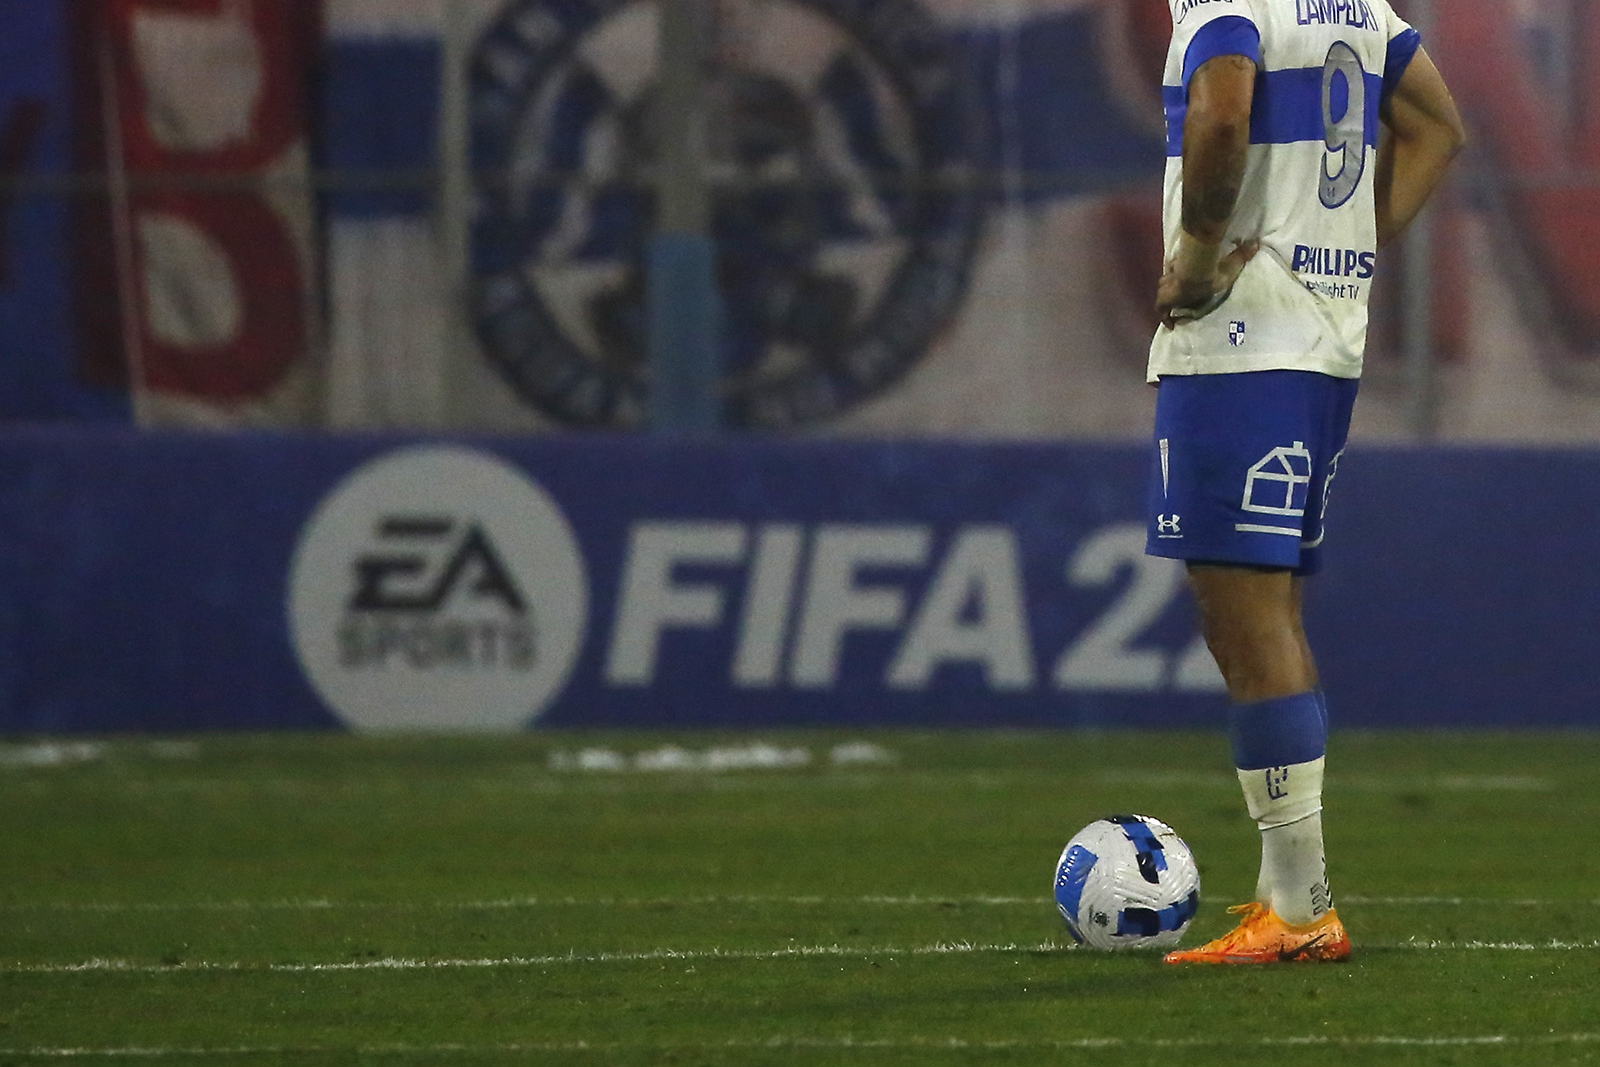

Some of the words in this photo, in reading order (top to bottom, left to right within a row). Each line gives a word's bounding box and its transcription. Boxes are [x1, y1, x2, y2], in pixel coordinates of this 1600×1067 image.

[1317, 40, 1365, 209] 9
[1291, 244, 1375, 279] PHILIPS
[349, 515, 529, 617] EA
[605, 521, 1036, 690] FIFA
